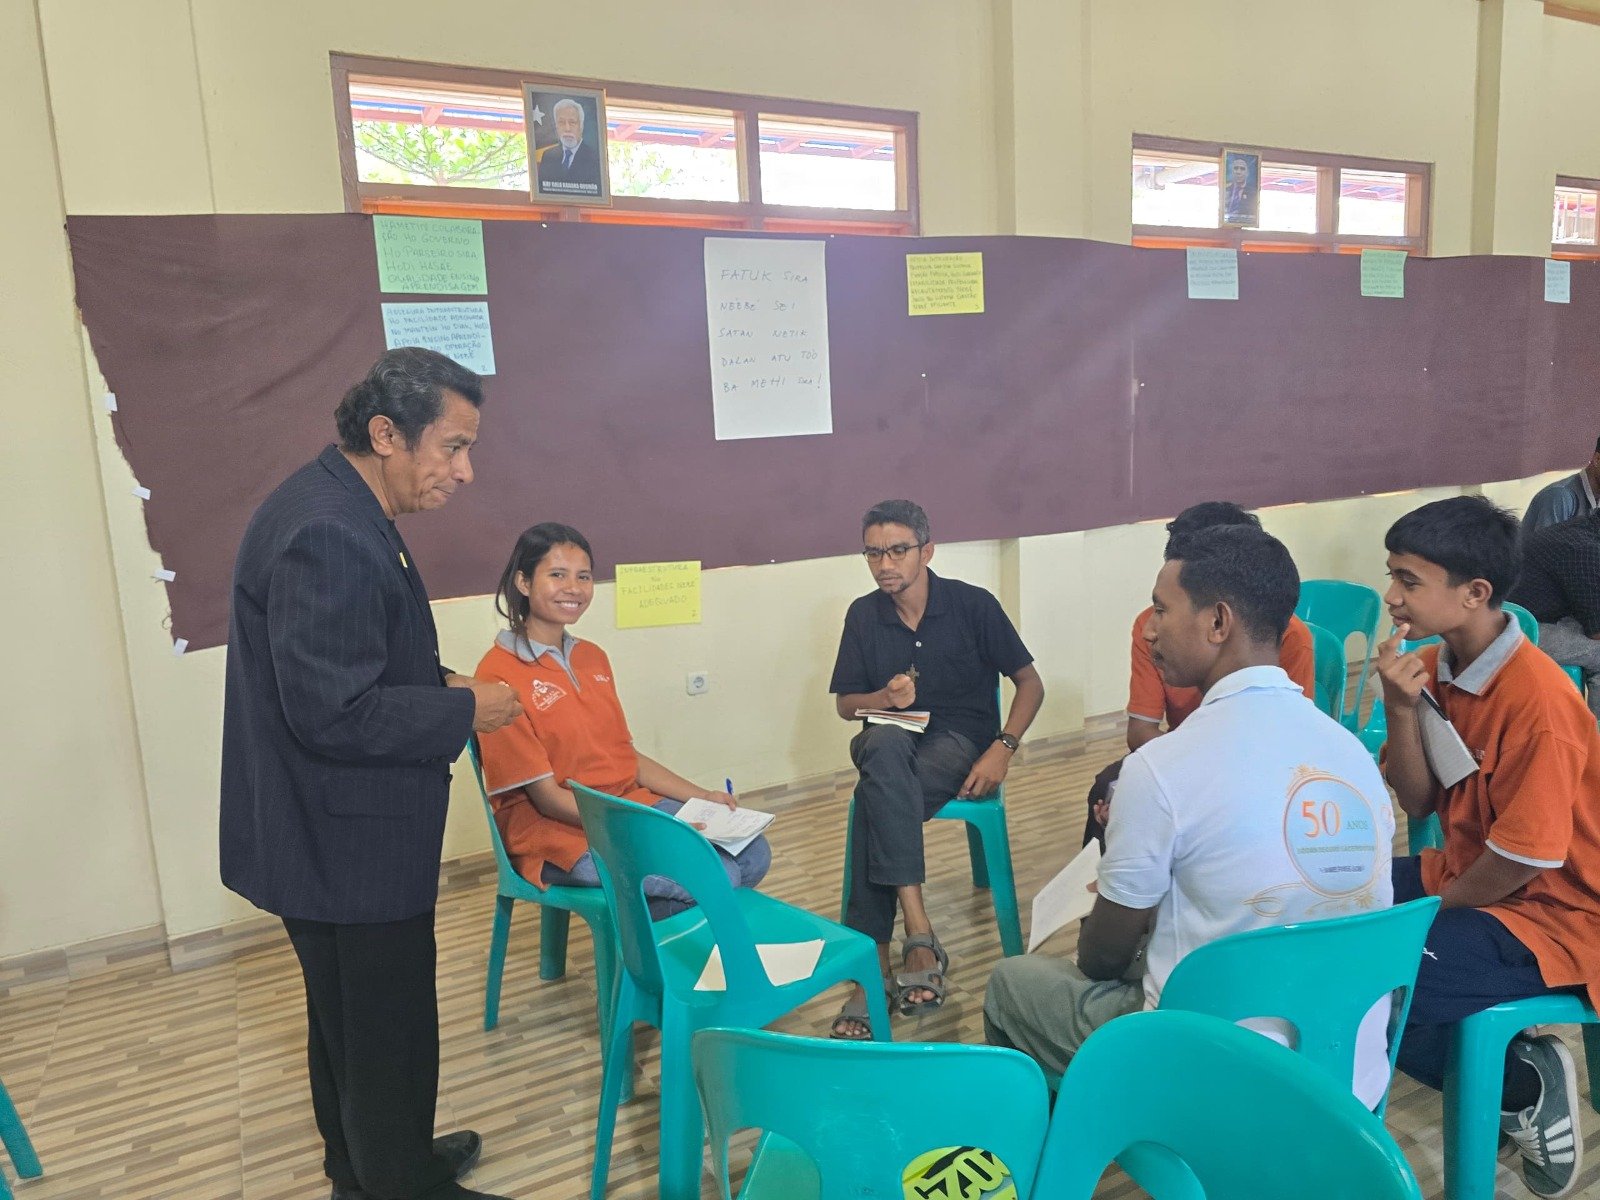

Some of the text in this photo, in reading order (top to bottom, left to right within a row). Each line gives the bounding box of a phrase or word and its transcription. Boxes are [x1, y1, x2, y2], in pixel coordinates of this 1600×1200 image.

[422, 234, 470, 246] GOVERNO
[457, 250, 477, 258] SIRA
[388, 273, 447, 283] QUALIDADE
[721, 269, 808, 283] FATUK SIRA
[718, 328, 753, 338] SATAN
[721, 357, 756, 368] DALAN
[771, 354, 792, 362] ATU
[723, 382, 739, 393] BA
[639, 595, 687, 608] ADEQUADO
[1302, 800, 1341, 838] 50
[1346, 820, 1368, 830] ANOS
